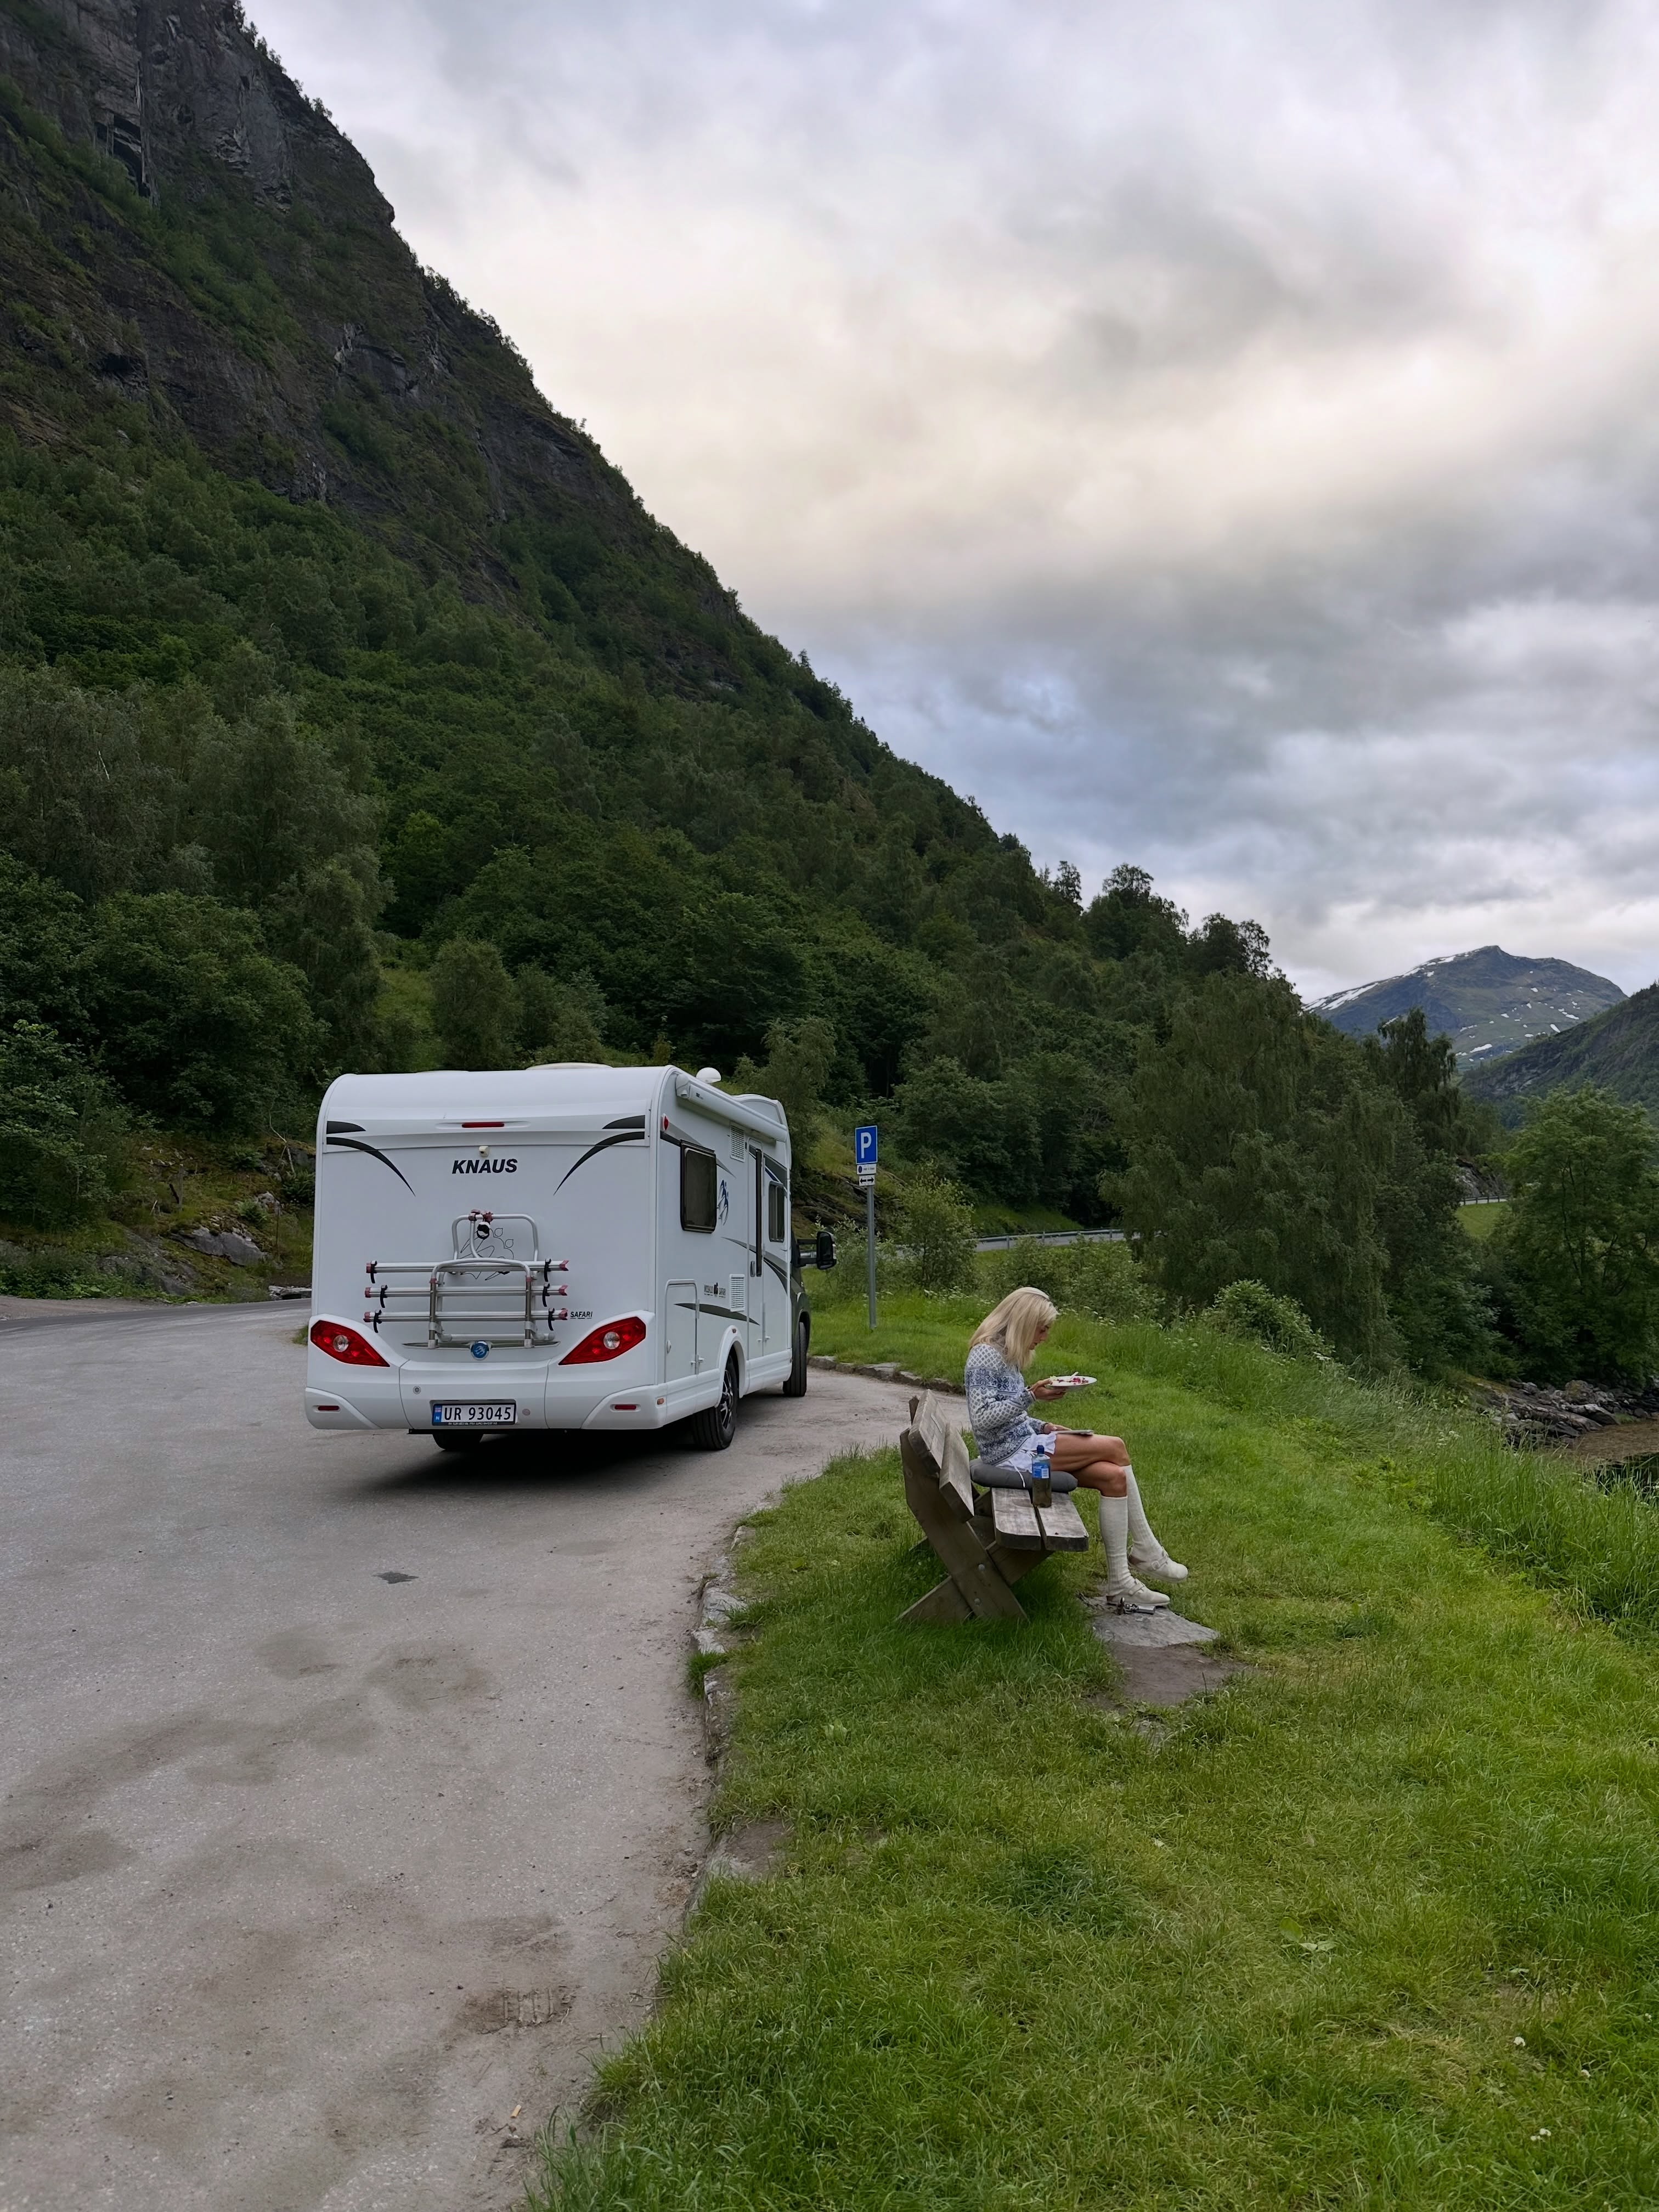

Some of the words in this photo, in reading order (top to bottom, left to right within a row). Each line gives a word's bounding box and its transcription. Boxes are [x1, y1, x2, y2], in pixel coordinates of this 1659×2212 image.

[860, 1132, 872, 1159] P
[452, 1159, 518, 1174] KNAUS
[444, 1407, 462, 1420] UR
[469, 1407, 511, 1420] 93045
